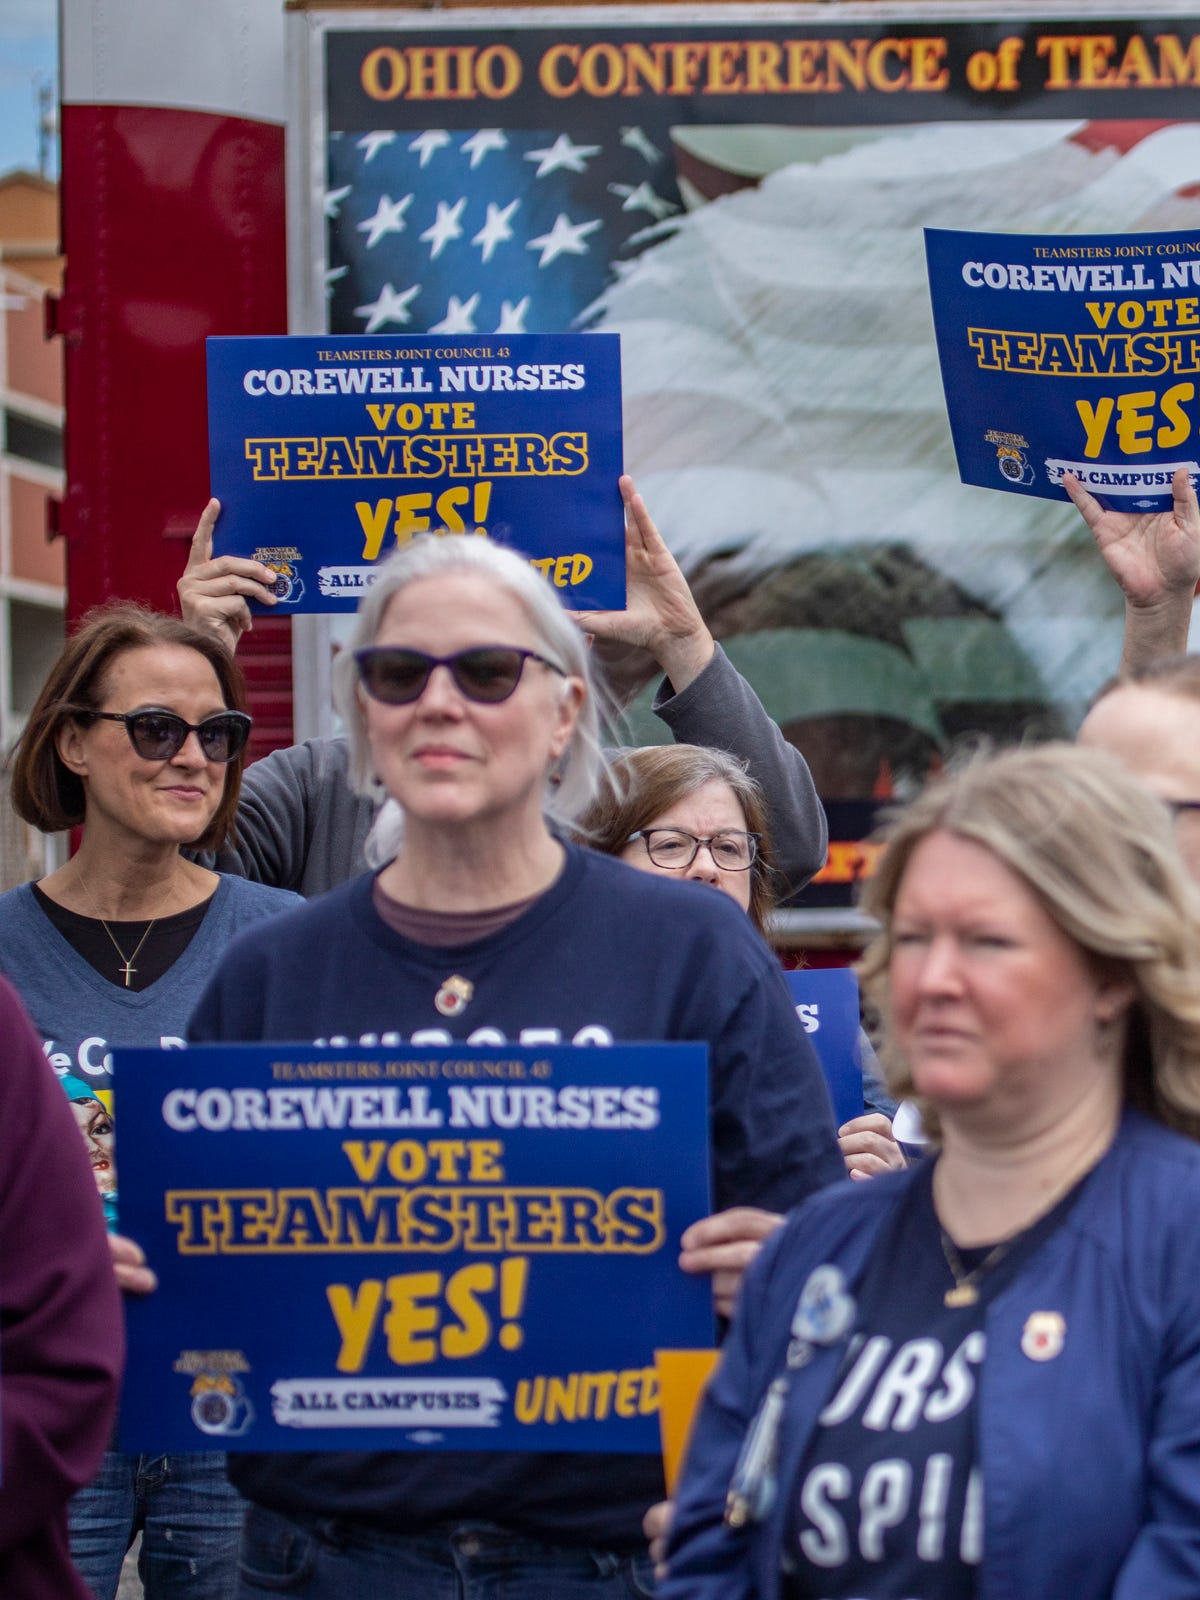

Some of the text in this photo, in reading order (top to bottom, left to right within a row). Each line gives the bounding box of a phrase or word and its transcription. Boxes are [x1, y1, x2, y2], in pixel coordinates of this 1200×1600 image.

[360, 45, 522, 101] OHIO
[539, 37, 950, 98] CONFERENCE
[966, 37, 1024, 92] of
[1033, 247, 1111, 258] TEAMSTERS
[1114, 246, 1154, 257] JOINT
[961, 261, 1155, 292] COREWELL
[1085, 297, 1200, 329] VOTE
[316, 347, 510, 361] TEAMSTERS JOINT COUNCIL 43
[243, 364, 585, 396] COREWELL NURSES
[366, 402, 476, 431] VOTE
[245, 432, 589, 481] TEAMSTERS
[330, 574, 364, 588] ALL
[271, 1061, 382, 1081] TEAMSTERS
[383, 1061, 439, 1080] JOINT
[441, 1061, 525, 1080] COUNCIL
[161, 1086, 660, 1132] COREWELL NURSES
[341, 1139, 505, 1182] VOTE
[165, 1186, 667, 1255] TEAMSTERS
[326, 1256, 530, 1373] YES!
[289, 1389, 482, 1411] ALL CAMPUSES
